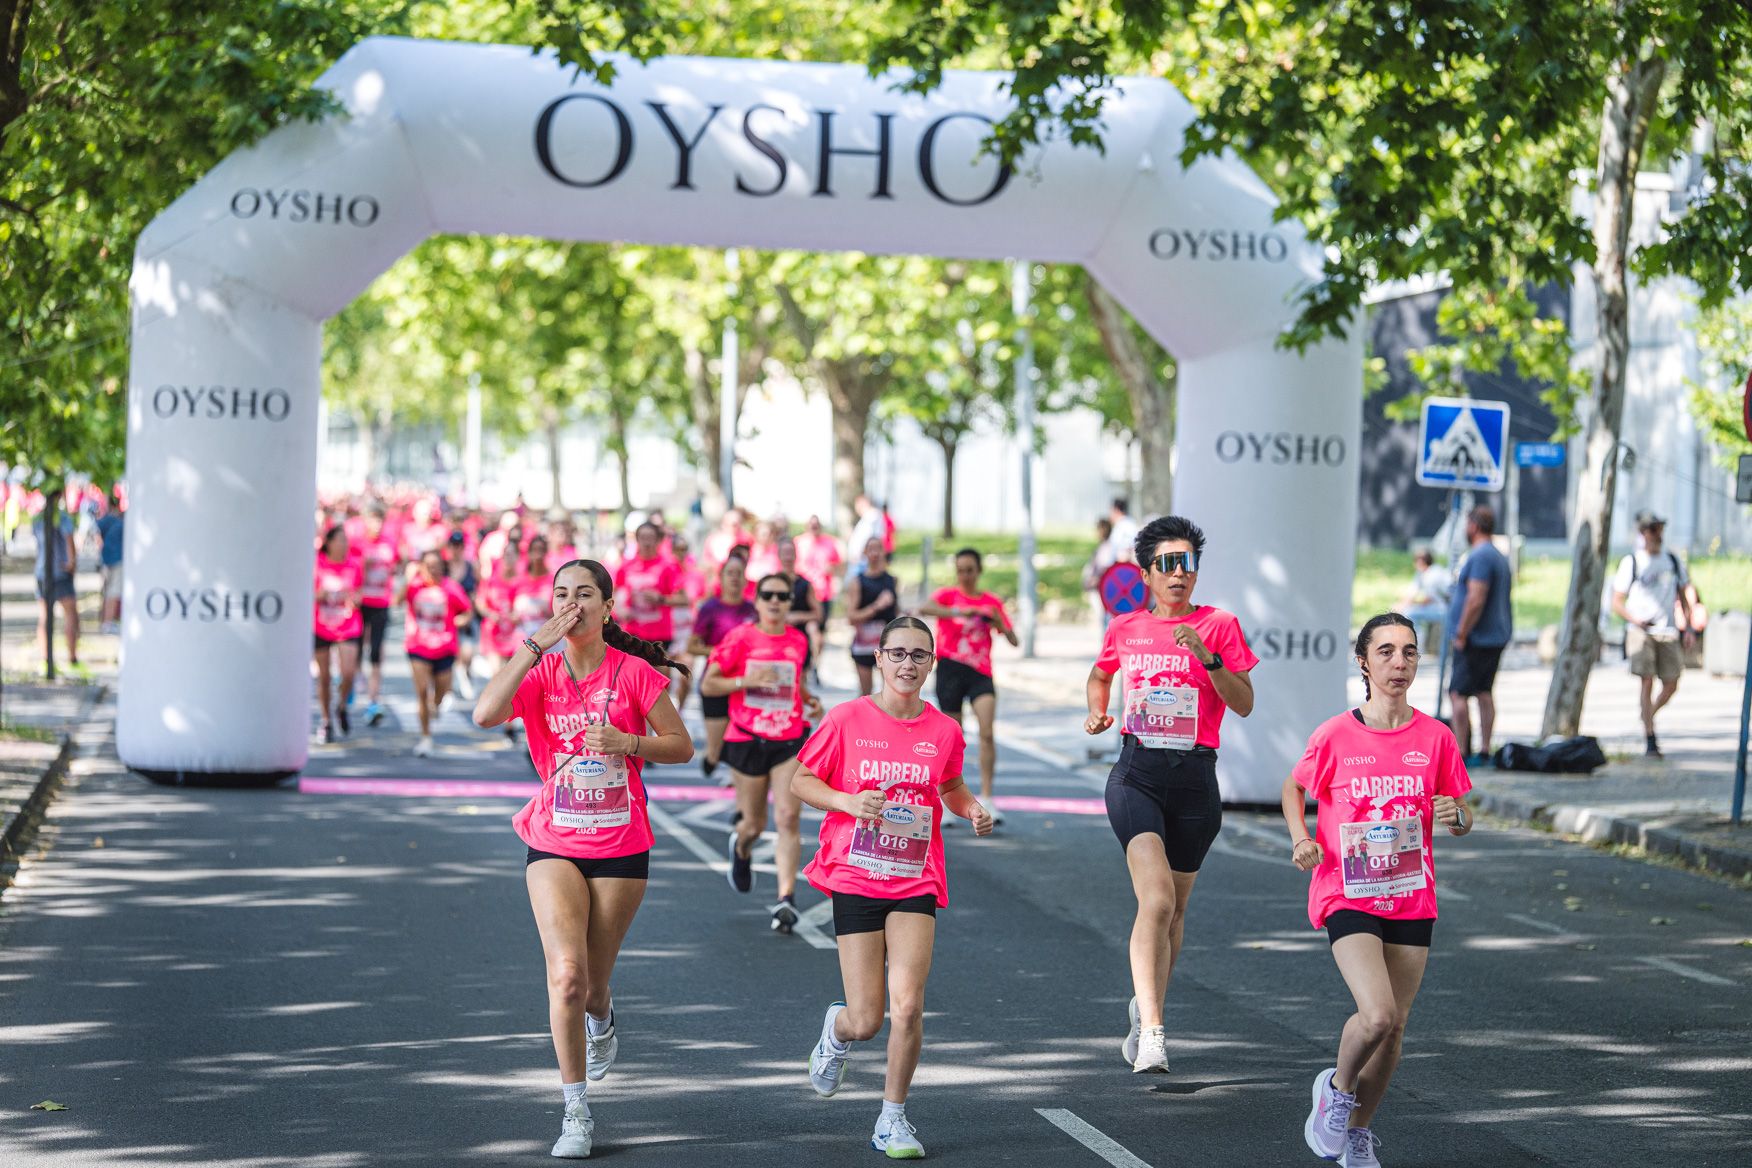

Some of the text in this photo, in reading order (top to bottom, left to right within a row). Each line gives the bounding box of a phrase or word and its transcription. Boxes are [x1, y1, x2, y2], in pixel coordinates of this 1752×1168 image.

[535, 93, 1014, 206] OYSHO
[231, 187, 379, 227] OYSHO
[1149, 228, 1287, 262] OYSHO
[154, 384, 290, 421] OYSHO
[1216, 431, 1346, 466] OYSHO
[146, 587, 282, 624] OYSHO
[1126, 638, 1154, 646] OYSHO
[1244, 627, 1337, 662] YSHO
[1128, 654, 1190, 672] CARRERA
[1148, 715, 1174, 726] 016
[856, 738, 888, 750] OYSHO
[1344, 756, 1376, 766] OYSHO
[574, 766, 605, 774] ASTURIANA
[860, 759, 930, 785] CARRERA
[1351, 776, 1425, 798] CARRERA
[575, 789, 605, 801] 016
[886, 811, 913, 822] ASTURIANA
[880, 834, 908, 849] 016
[856, 858, 882, 869] OYSHO
[1370, 854, 1400, 868] 016
[1373, 900, 1394, 911] 2026
